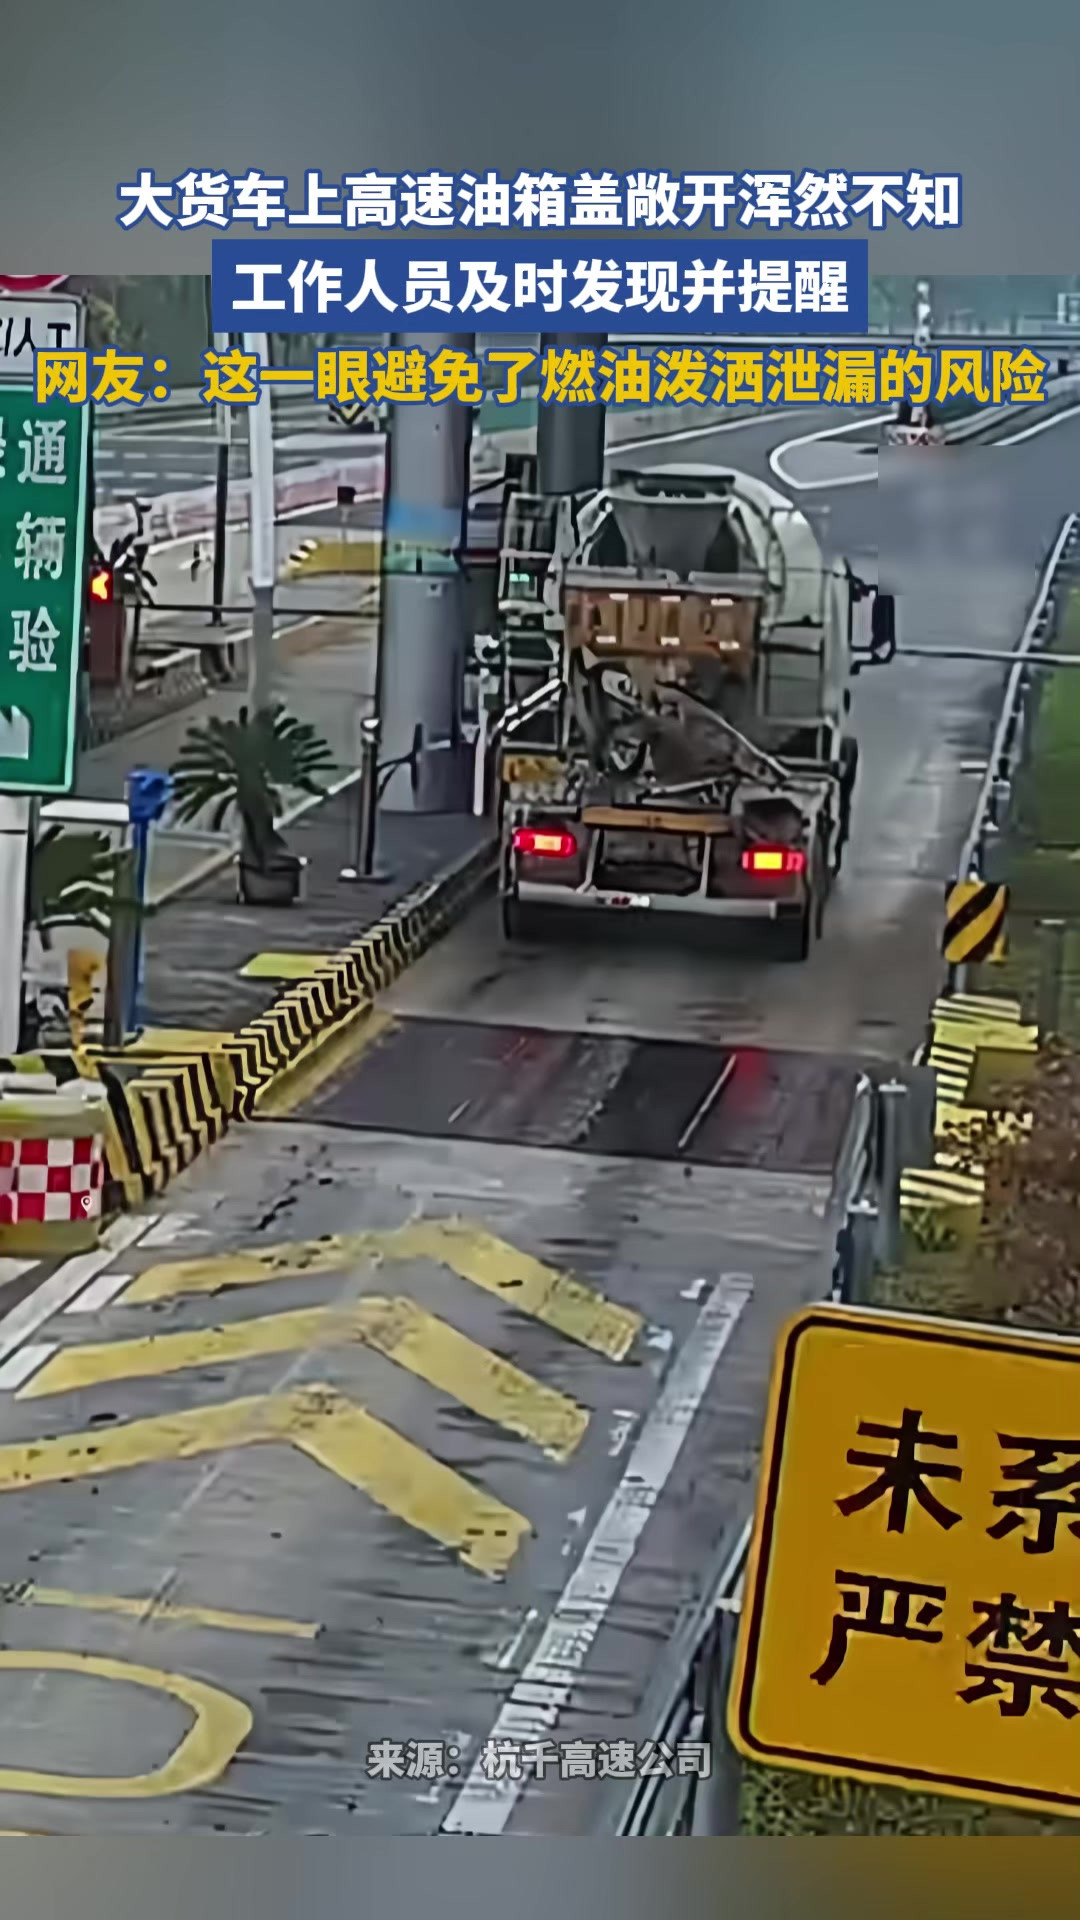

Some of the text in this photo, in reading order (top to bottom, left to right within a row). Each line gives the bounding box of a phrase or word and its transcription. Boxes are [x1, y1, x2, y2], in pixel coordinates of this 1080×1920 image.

[0, 417, 67, 484] 通
[9, 606, 60, 672] 验
[834, 1408, 1080, 1554] 未系
[810, 1569, 1080, 1720] 严禁
